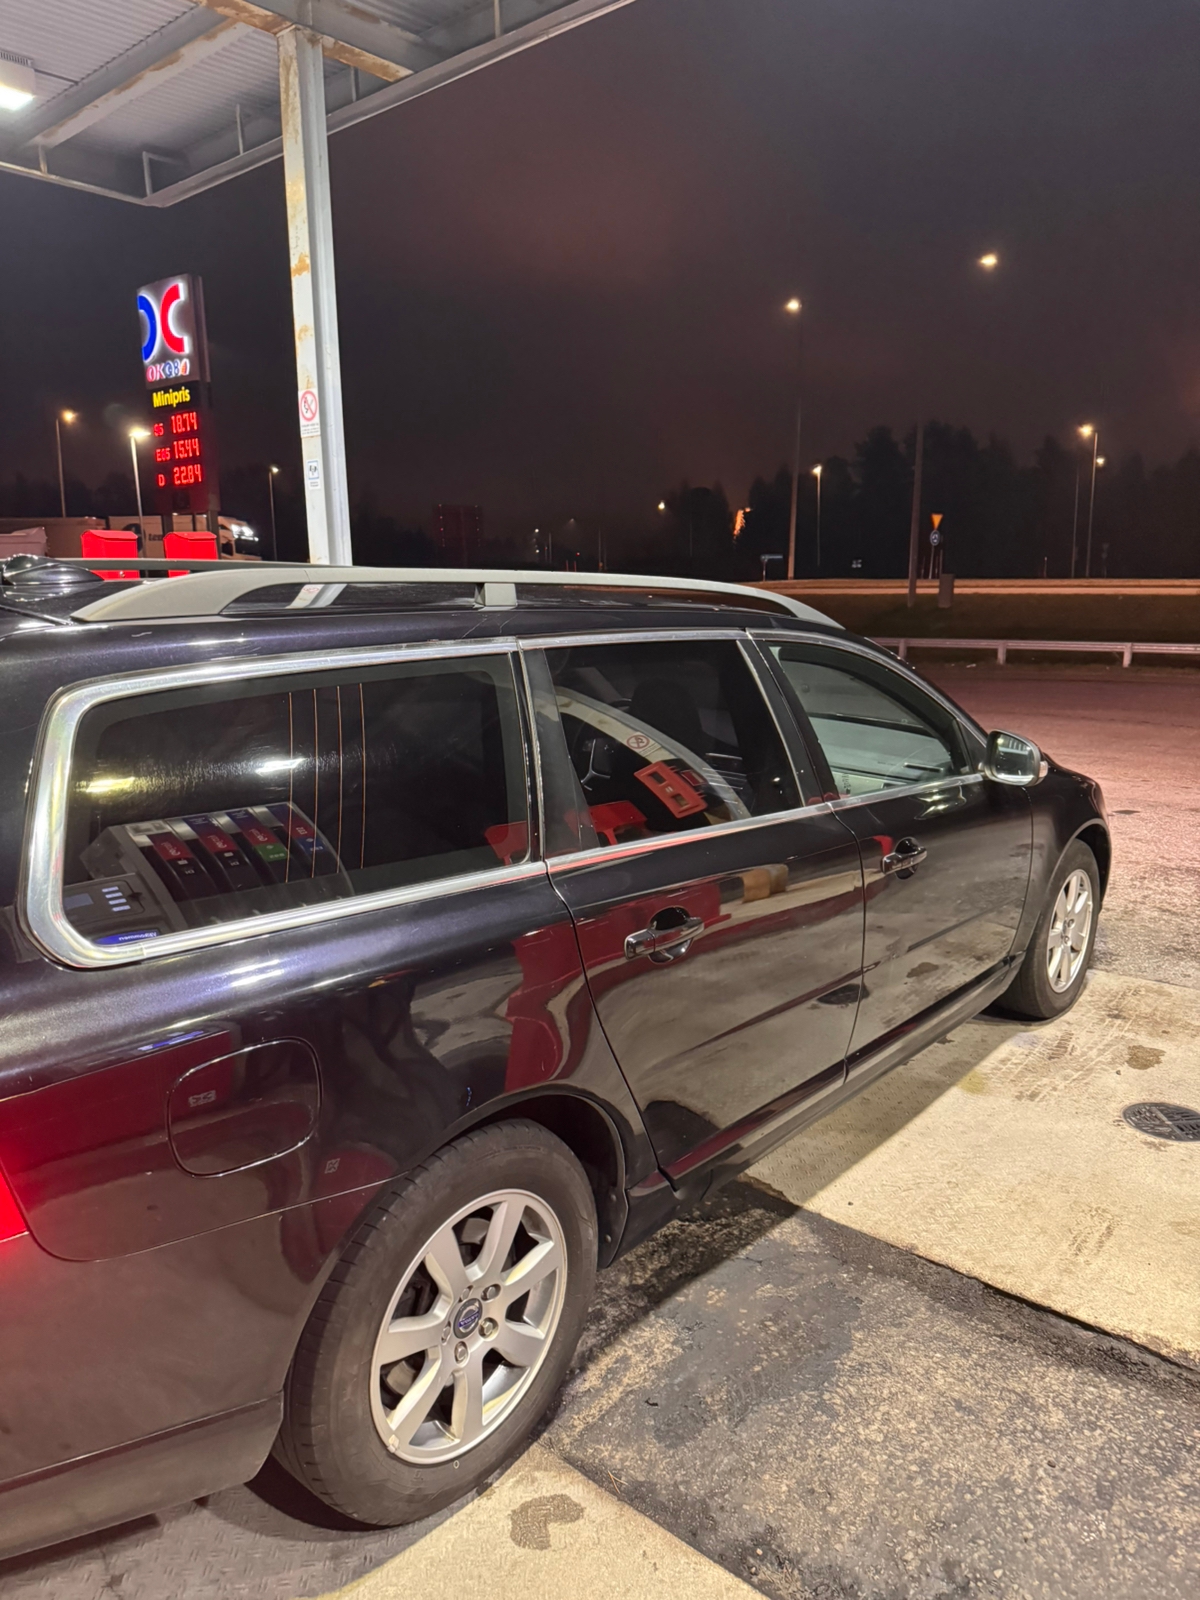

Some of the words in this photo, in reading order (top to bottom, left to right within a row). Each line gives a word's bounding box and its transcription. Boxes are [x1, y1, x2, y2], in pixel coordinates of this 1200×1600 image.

[152, 386, 191, 408] Minipris
[173, 438, 200, 459] 15.44
[158, 473, 166, 486] D
